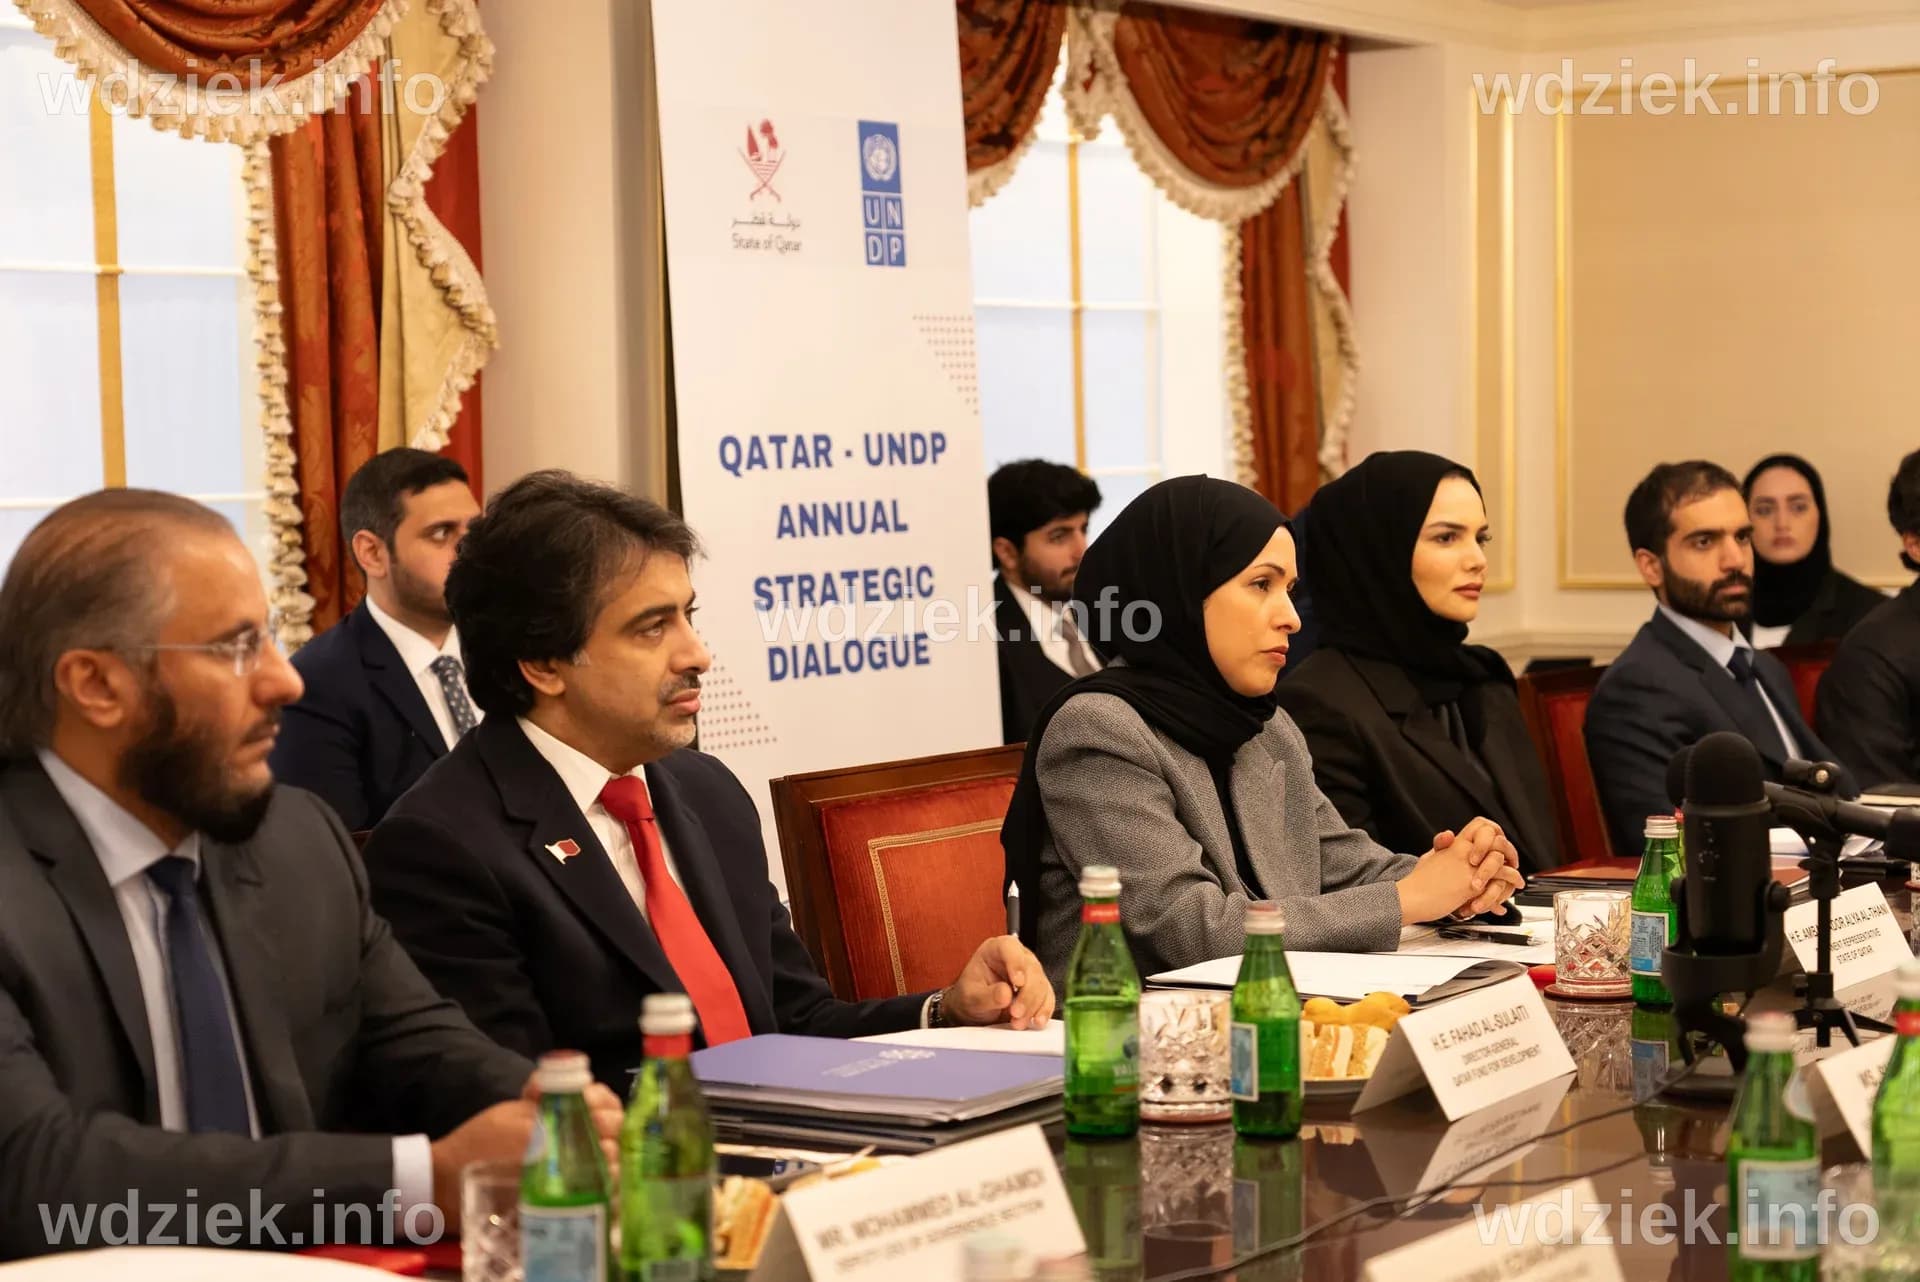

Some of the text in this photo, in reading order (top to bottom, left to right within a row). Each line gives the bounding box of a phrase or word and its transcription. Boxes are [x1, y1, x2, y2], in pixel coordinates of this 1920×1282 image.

[732, 233, 761, 249] State
[719, 433, 832, 477] QATAR
[864, 432, 947, 467] UNDP
[776, 500, 909, 539] ANNUAL
[753, 564, 935, 611] STRATEGIC
[768, 632, 930, 682] DIALOGUE
[1450, 1022, 1482, 1043] FAHAD
